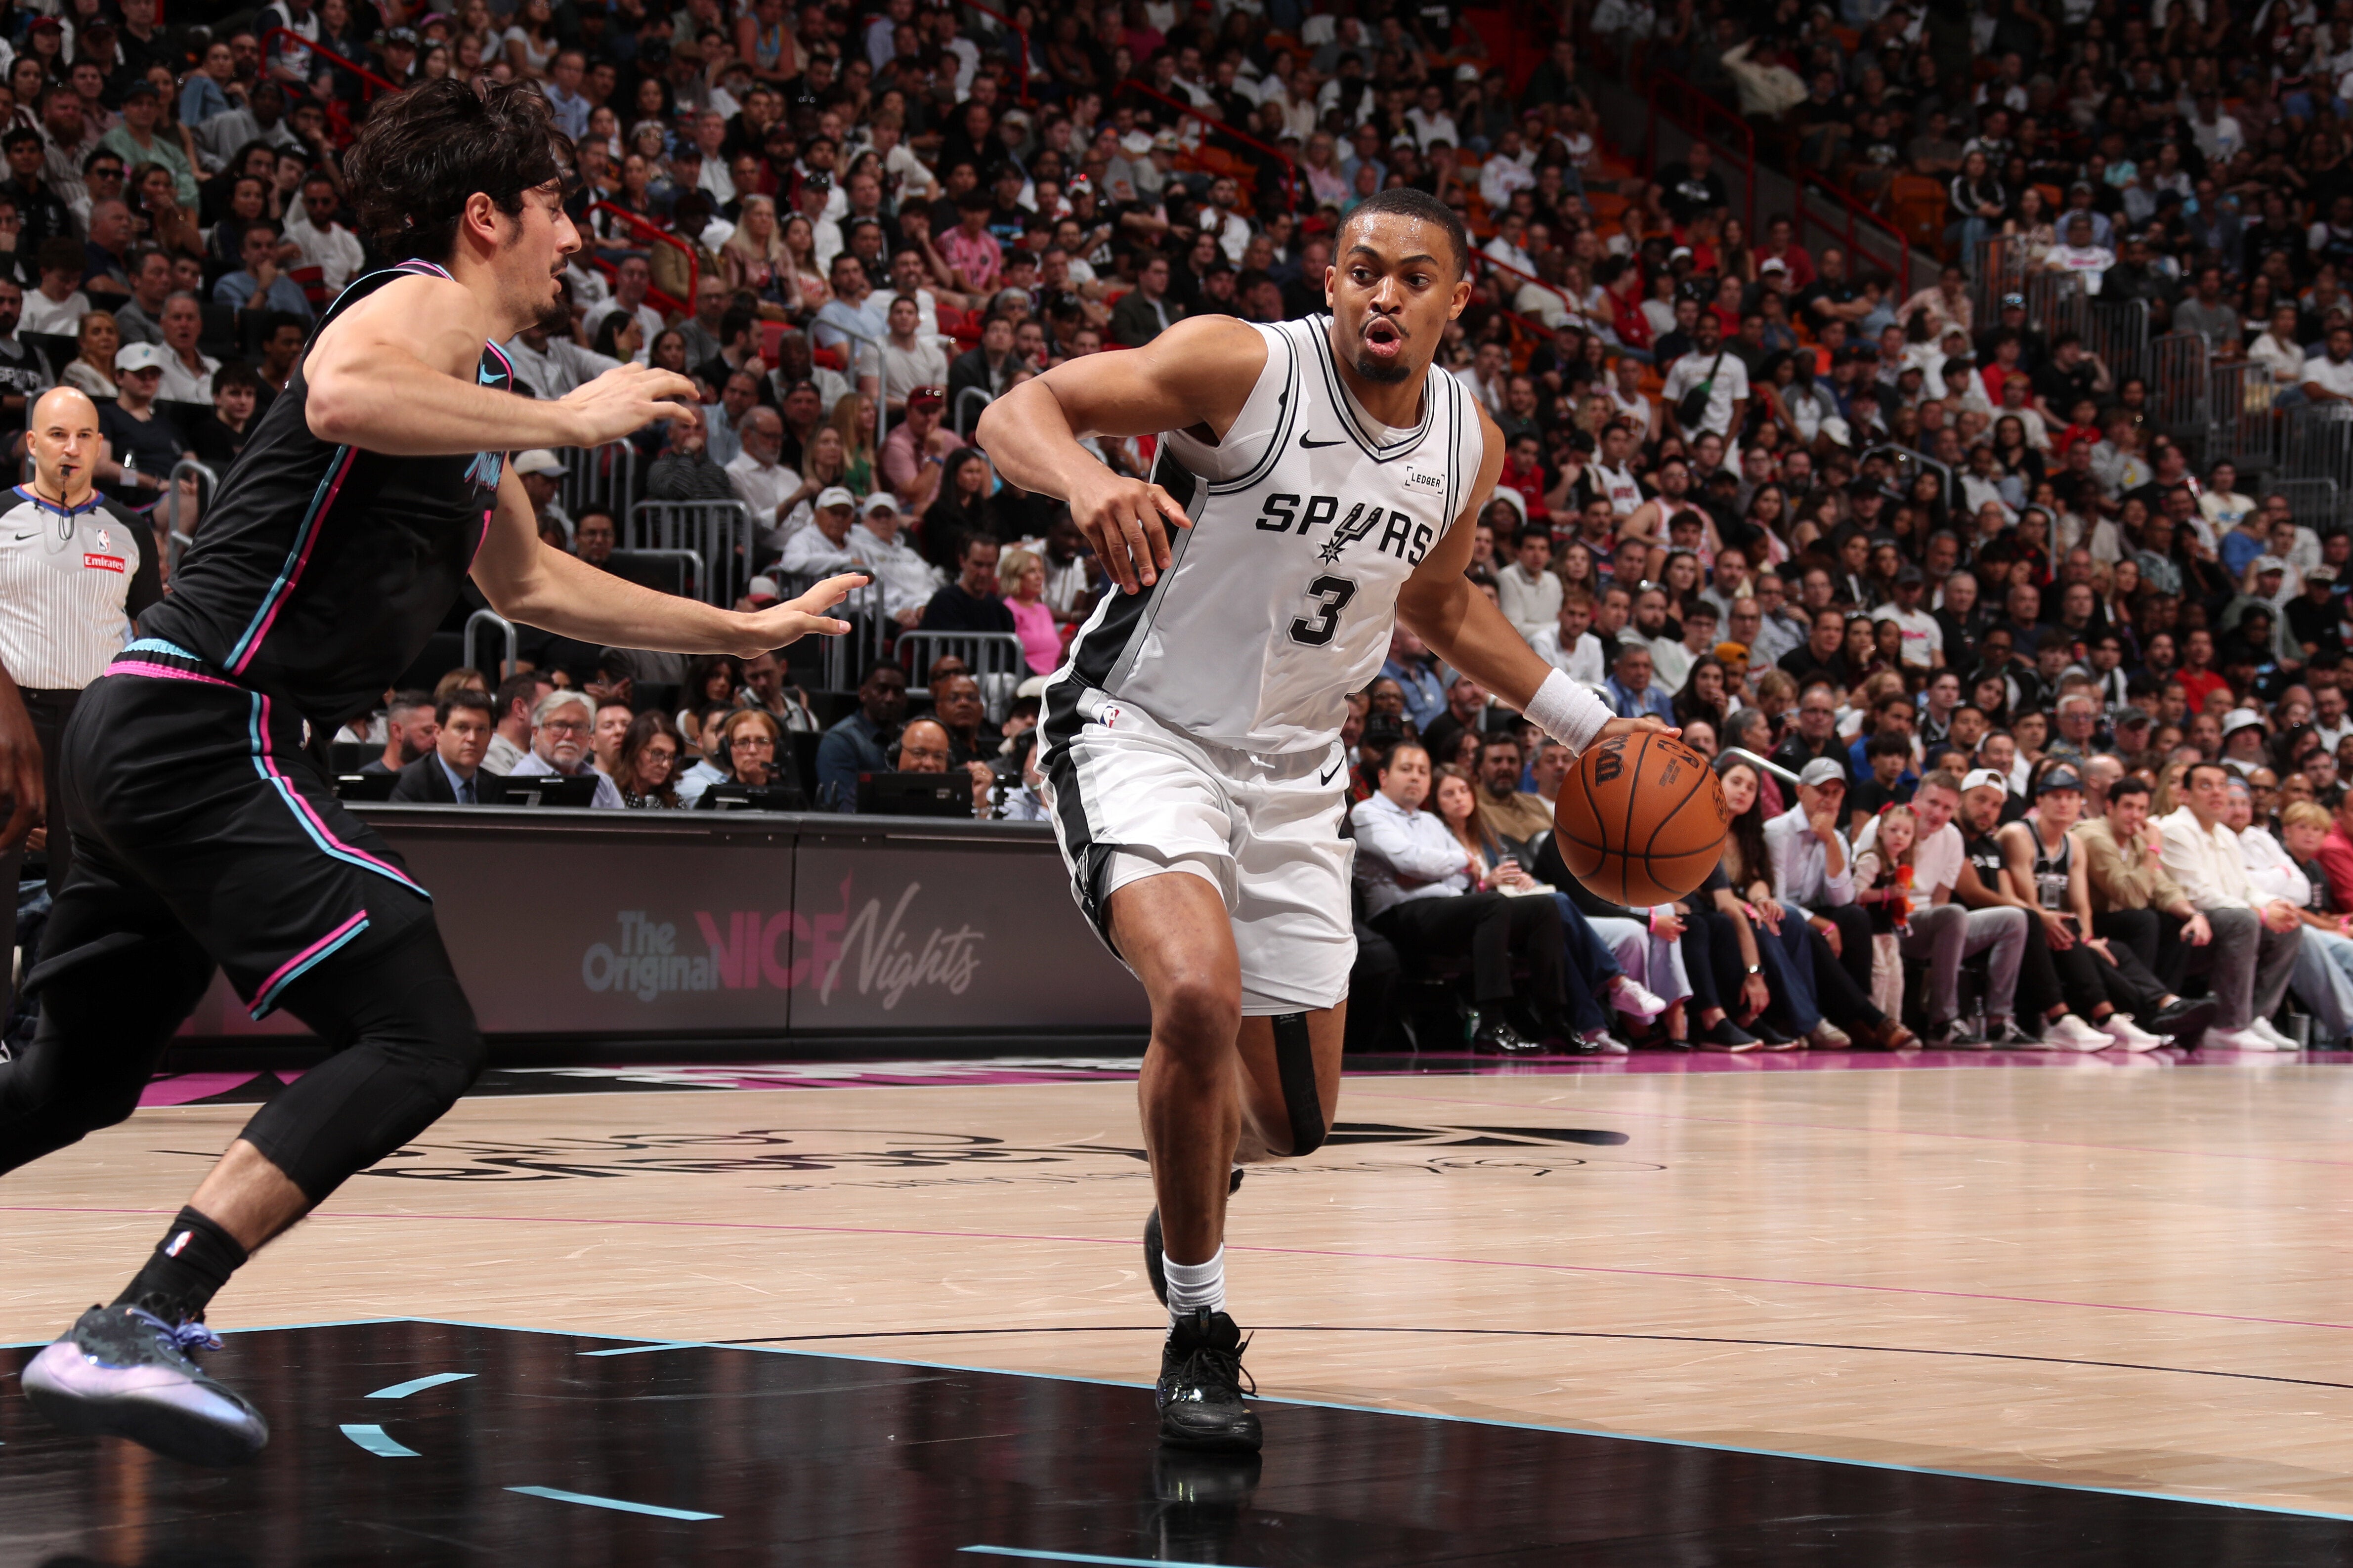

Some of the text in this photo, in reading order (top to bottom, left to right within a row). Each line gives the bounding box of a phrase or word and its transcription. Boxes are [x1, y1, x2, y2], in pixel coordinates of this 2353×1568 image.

[1411, 471, 1441, 489] LEDGER
[1256, 493, 1433, 566] SPURS
[85, 555, 124, 571] Emirates
[1286, 573, 1359, 648] 3
[582, 869, 985, 1011] Original VICE Nights
[617, 910, 677, 956] The
[832, 1178, 1078, 1190] Court
